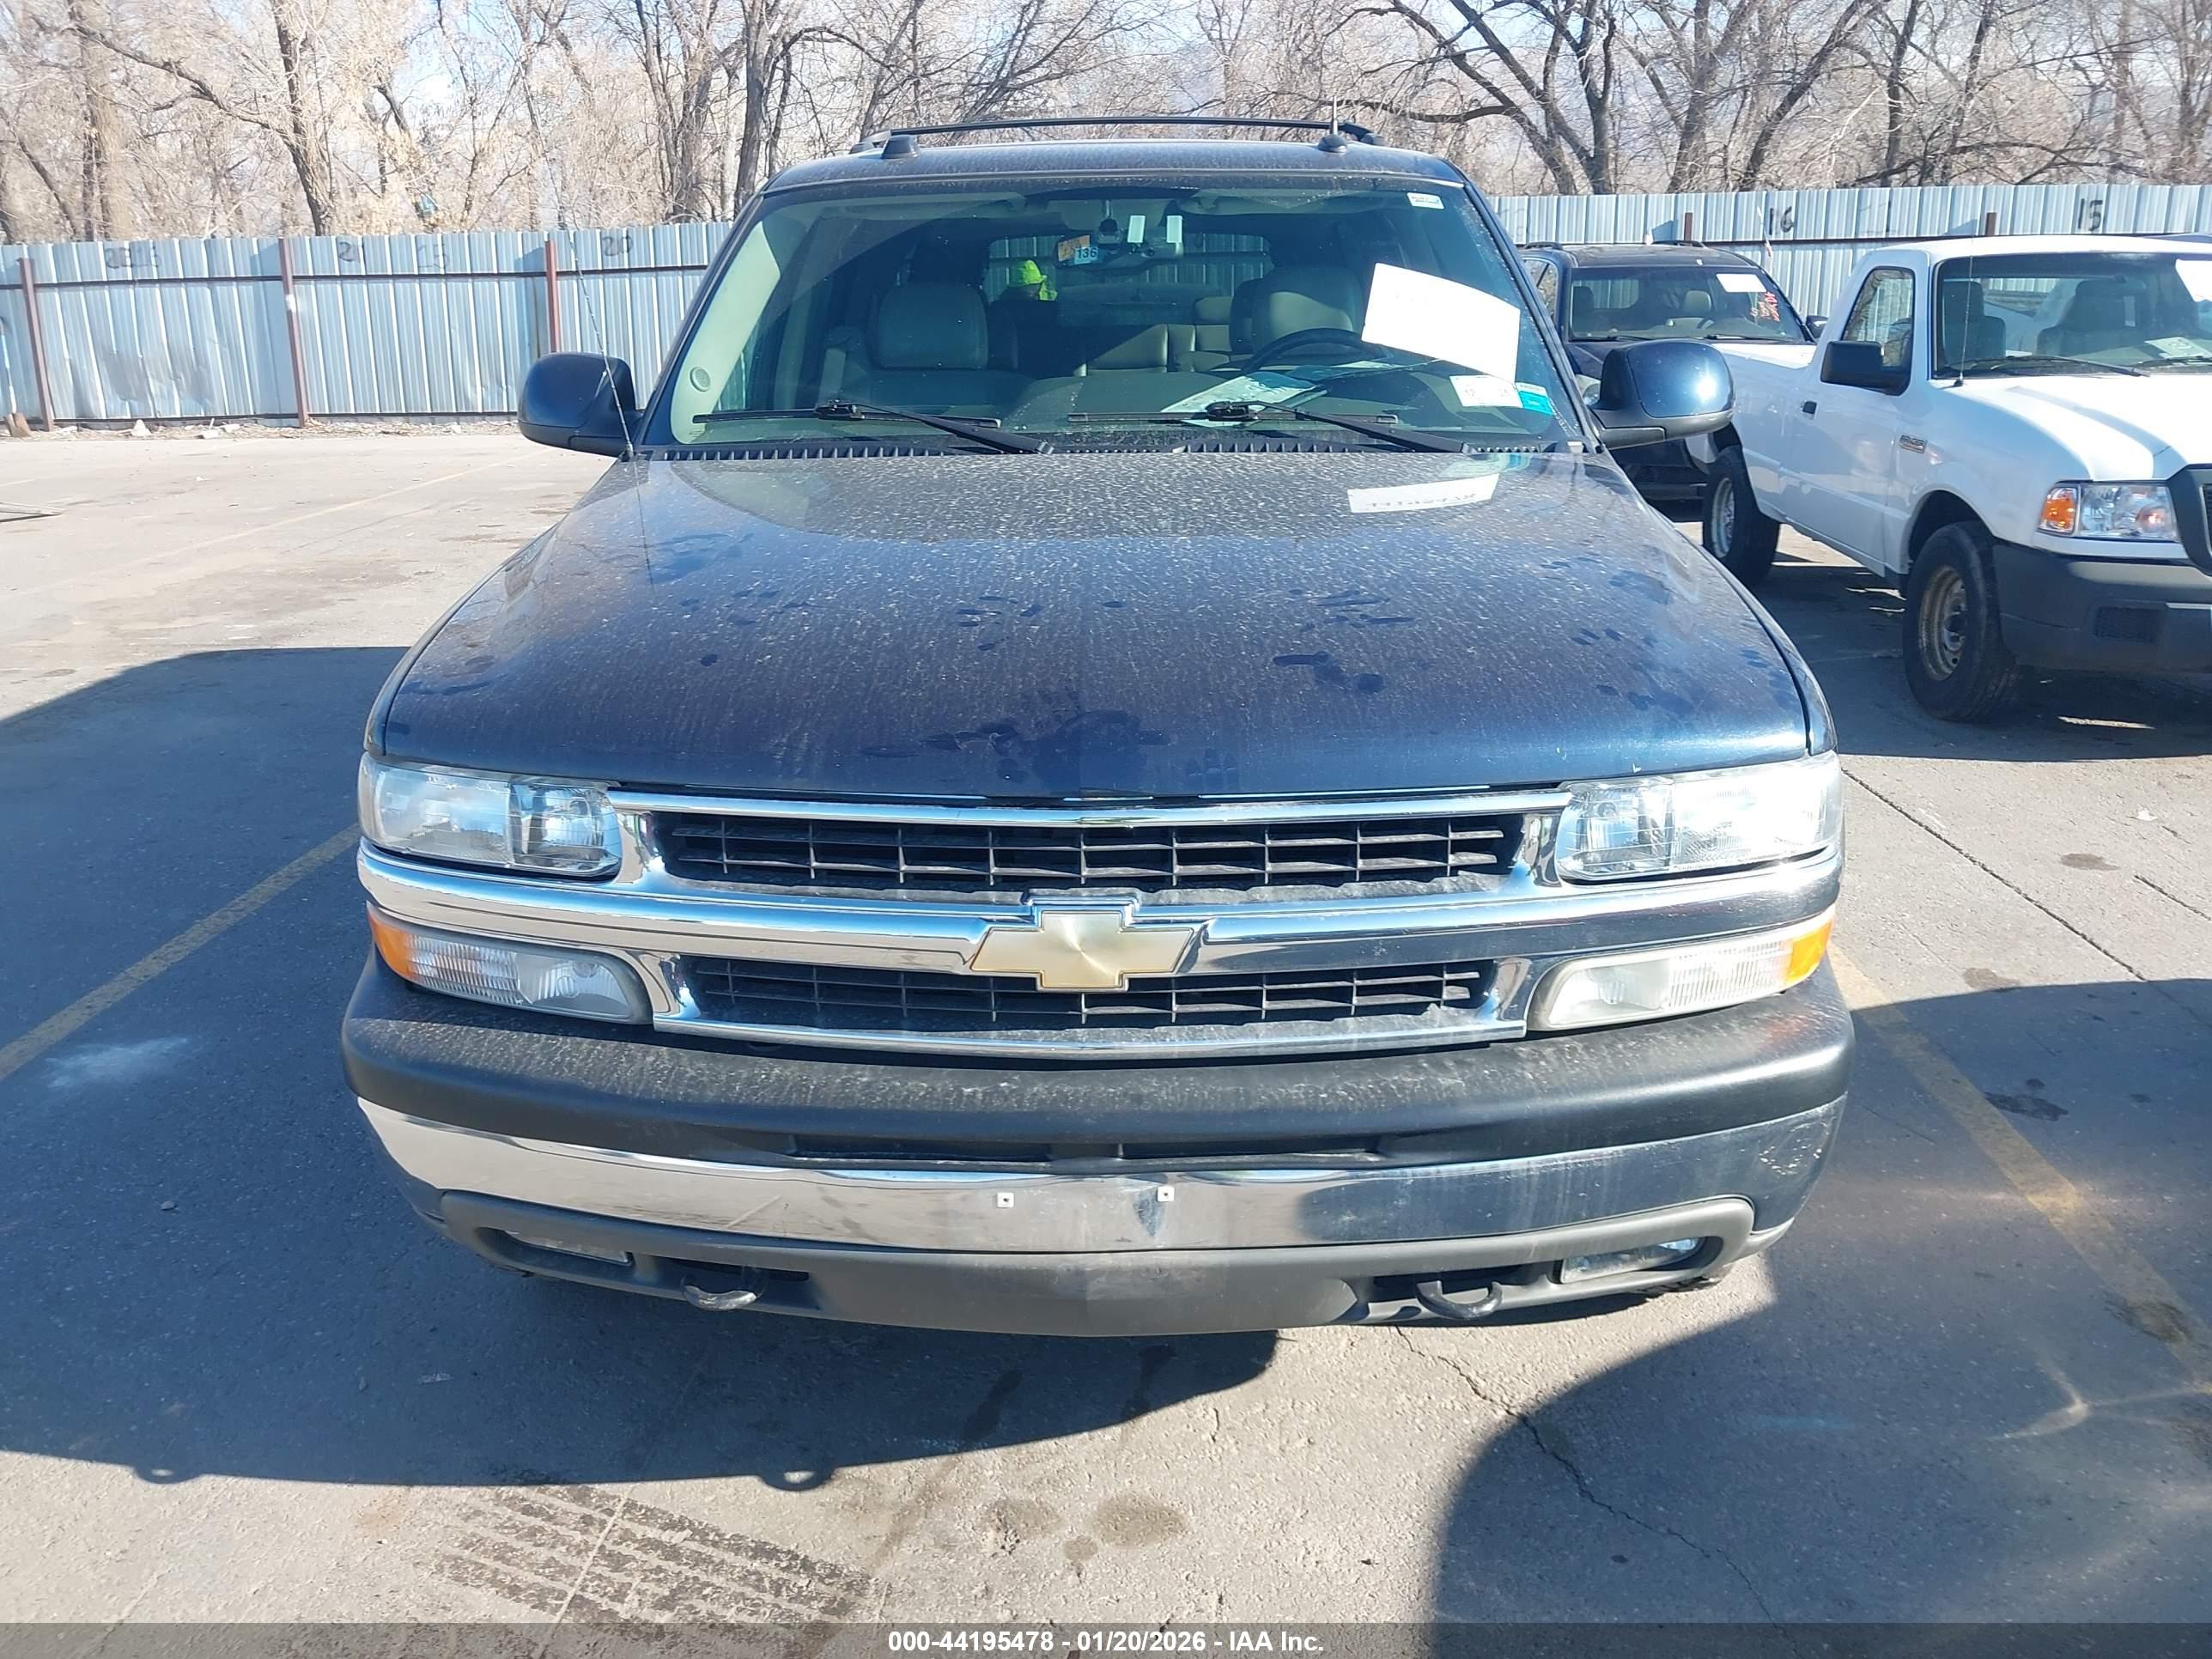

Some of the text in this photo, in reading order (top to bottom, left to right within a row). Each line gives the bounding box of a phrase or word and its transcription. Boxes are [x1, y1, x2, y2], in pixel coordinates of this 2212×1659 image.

[1769, 206, 1794, 235] 16
[2077, 198, 2103, 231] 15
[603, 234, 633, 257] 20
[1077, 247, 1097, 259] 136
